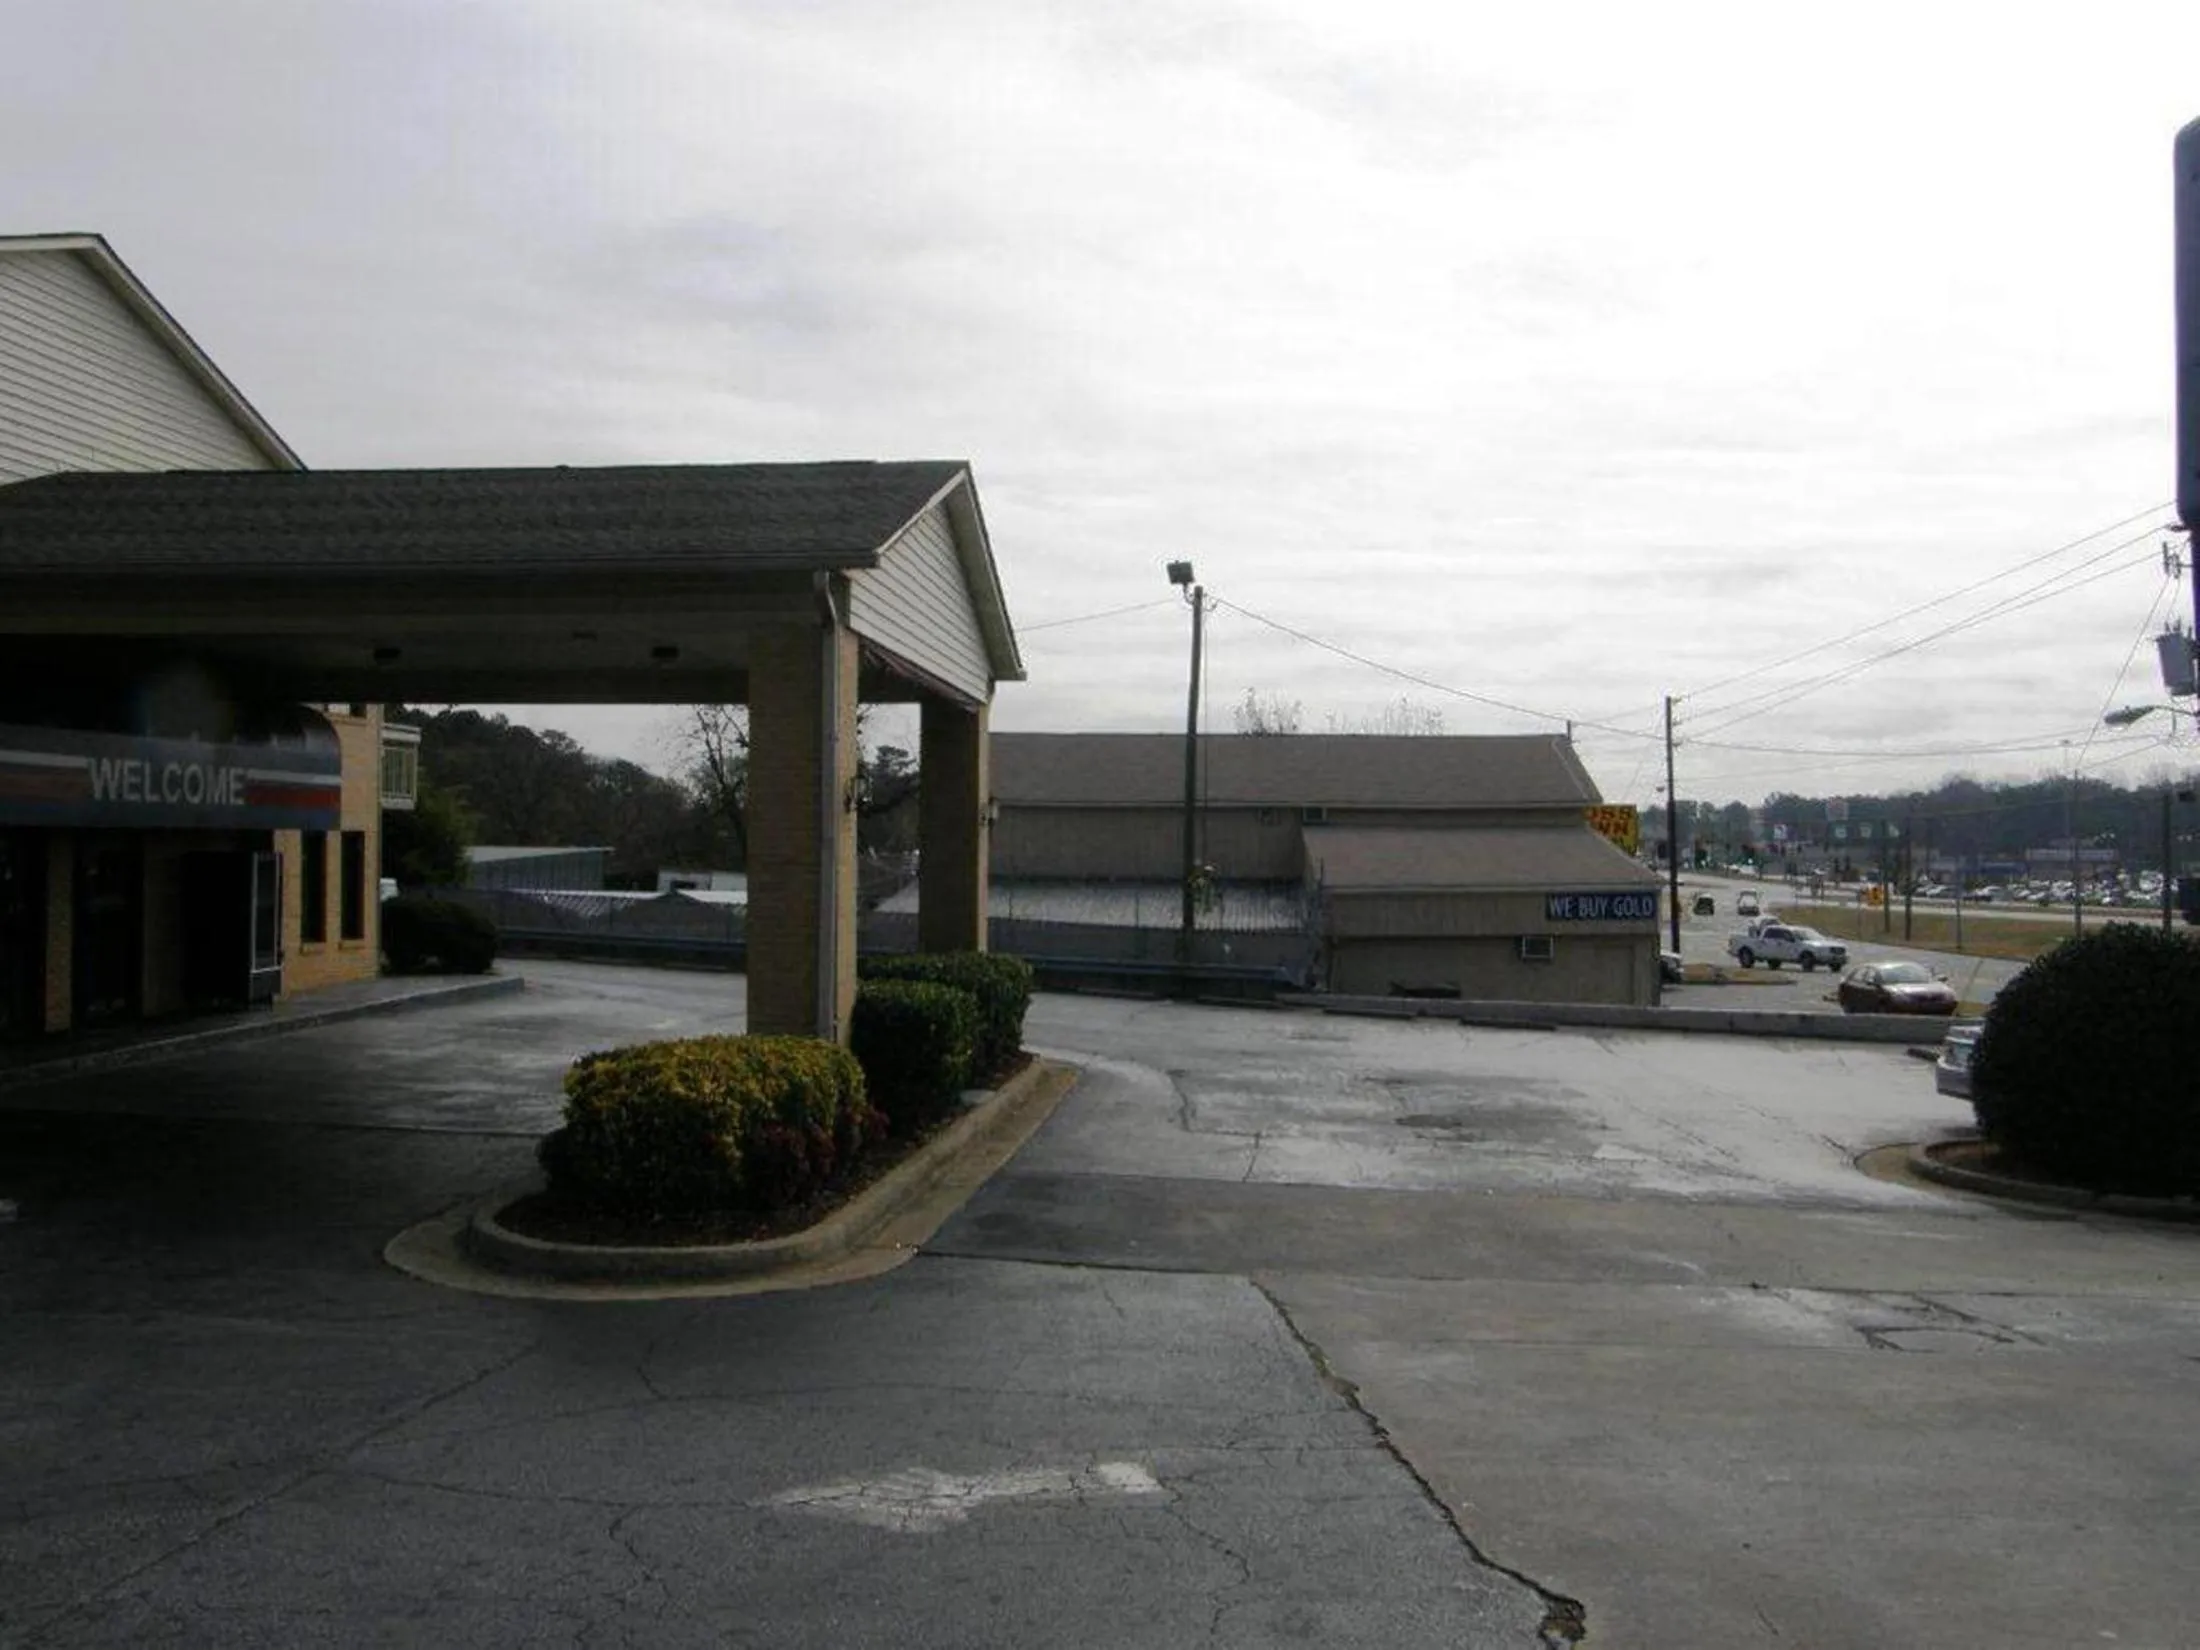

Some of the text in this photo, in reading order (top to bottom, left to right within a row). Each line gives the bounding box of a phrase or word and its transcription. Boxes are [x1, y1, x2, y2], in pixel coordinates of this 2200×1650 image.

[90, 758, 245, 806] WELCOME
[1549, 896, 1653, 917] WE BUY GOLD
